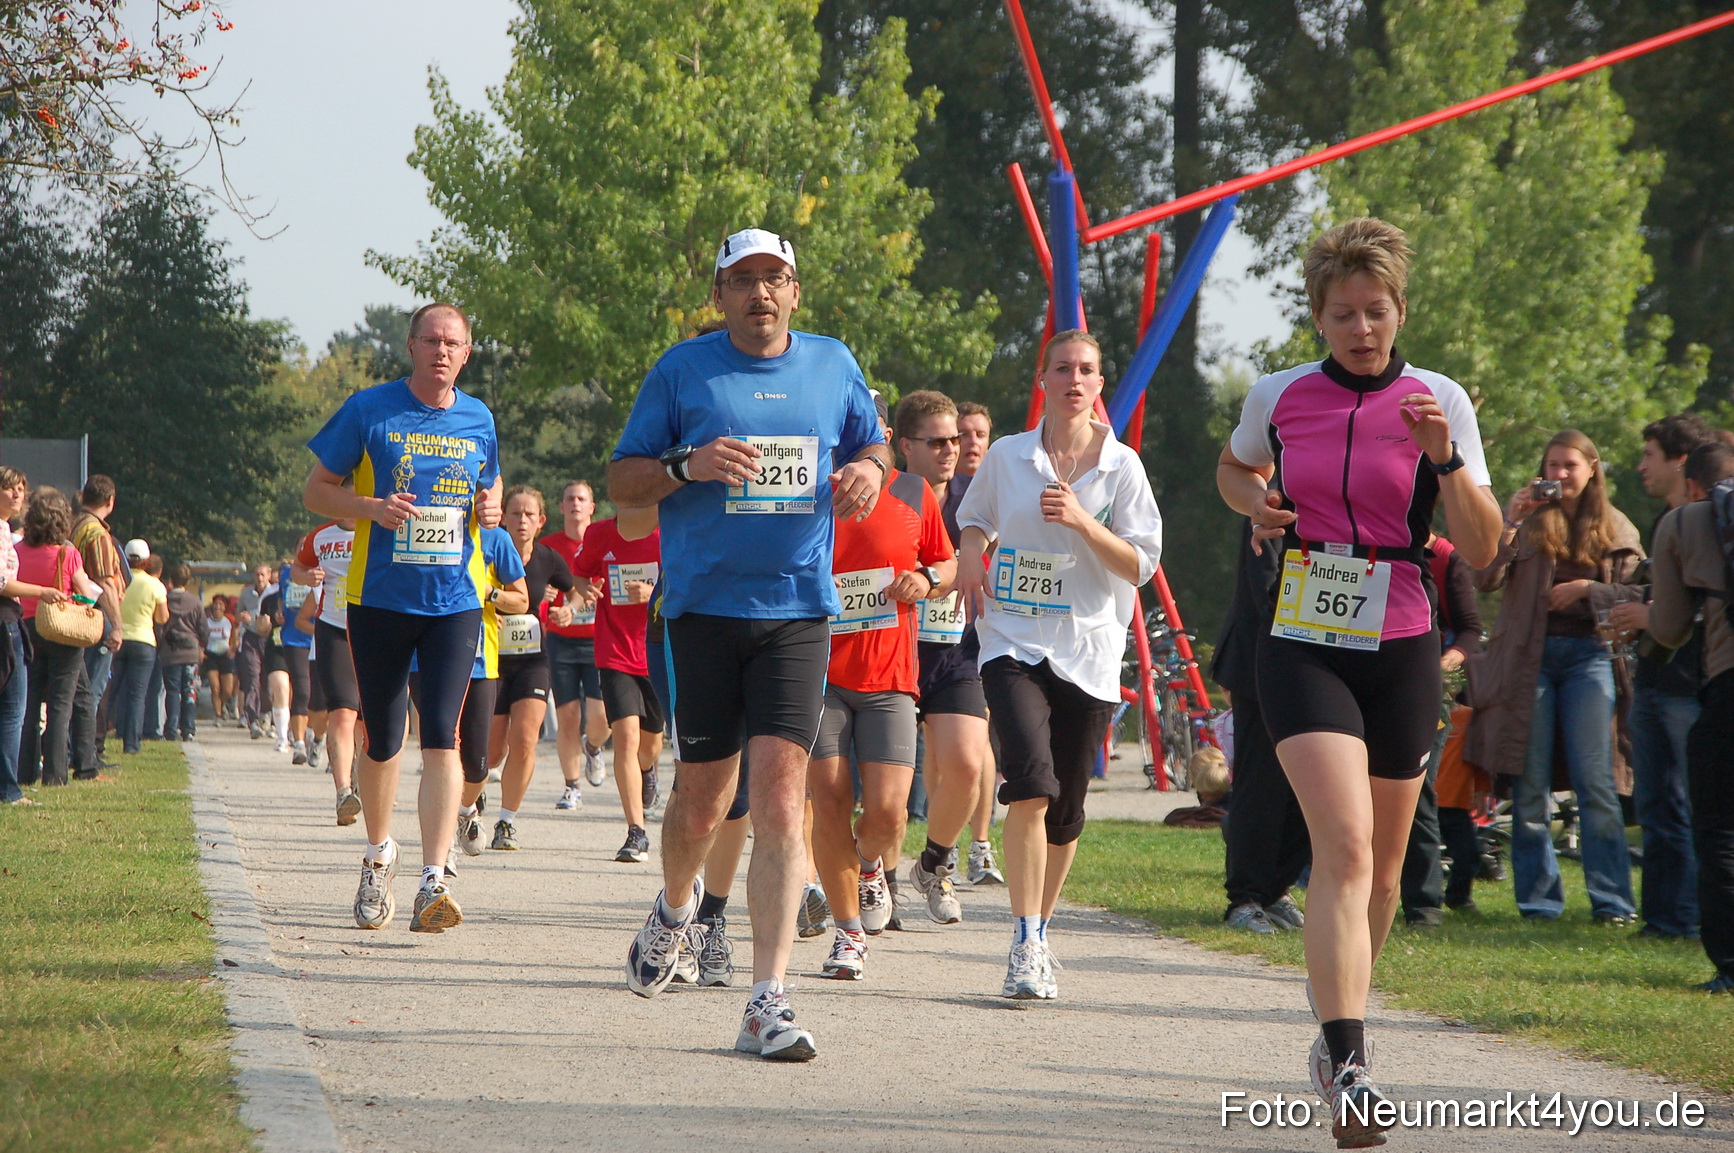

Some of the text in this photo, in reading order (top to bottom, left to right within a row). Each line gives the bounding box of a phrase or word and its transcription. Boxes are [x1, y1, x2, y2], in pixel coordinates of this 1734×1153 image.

[388, 432, 477, 453] 10. NEUMARKTER
[403, 443, 467, 460] STADTLAUF
[753, 443, 803, 460] Wolfgang
[755, 466, 808, 486] 3216
[415, 512, 447, 523] Michael
[415, 528, 455, 544] 2221
[1019, 556, 1052, 571] Andrea
[1310, 561, 1359, 584] Andrea
[841, 577, 871, 589] Stefan
[1017, 575, 1063, 596] 2781
[1284, 582, 1292, 596] D
[844, 591, 888, 611] 2700
[1315, 590, 1368, 619] 567
[929, 609, 964, 624] 3453
[511, 630, 532, 641] 821
[1337, 633, 1379, 645] PFLEIDERER
